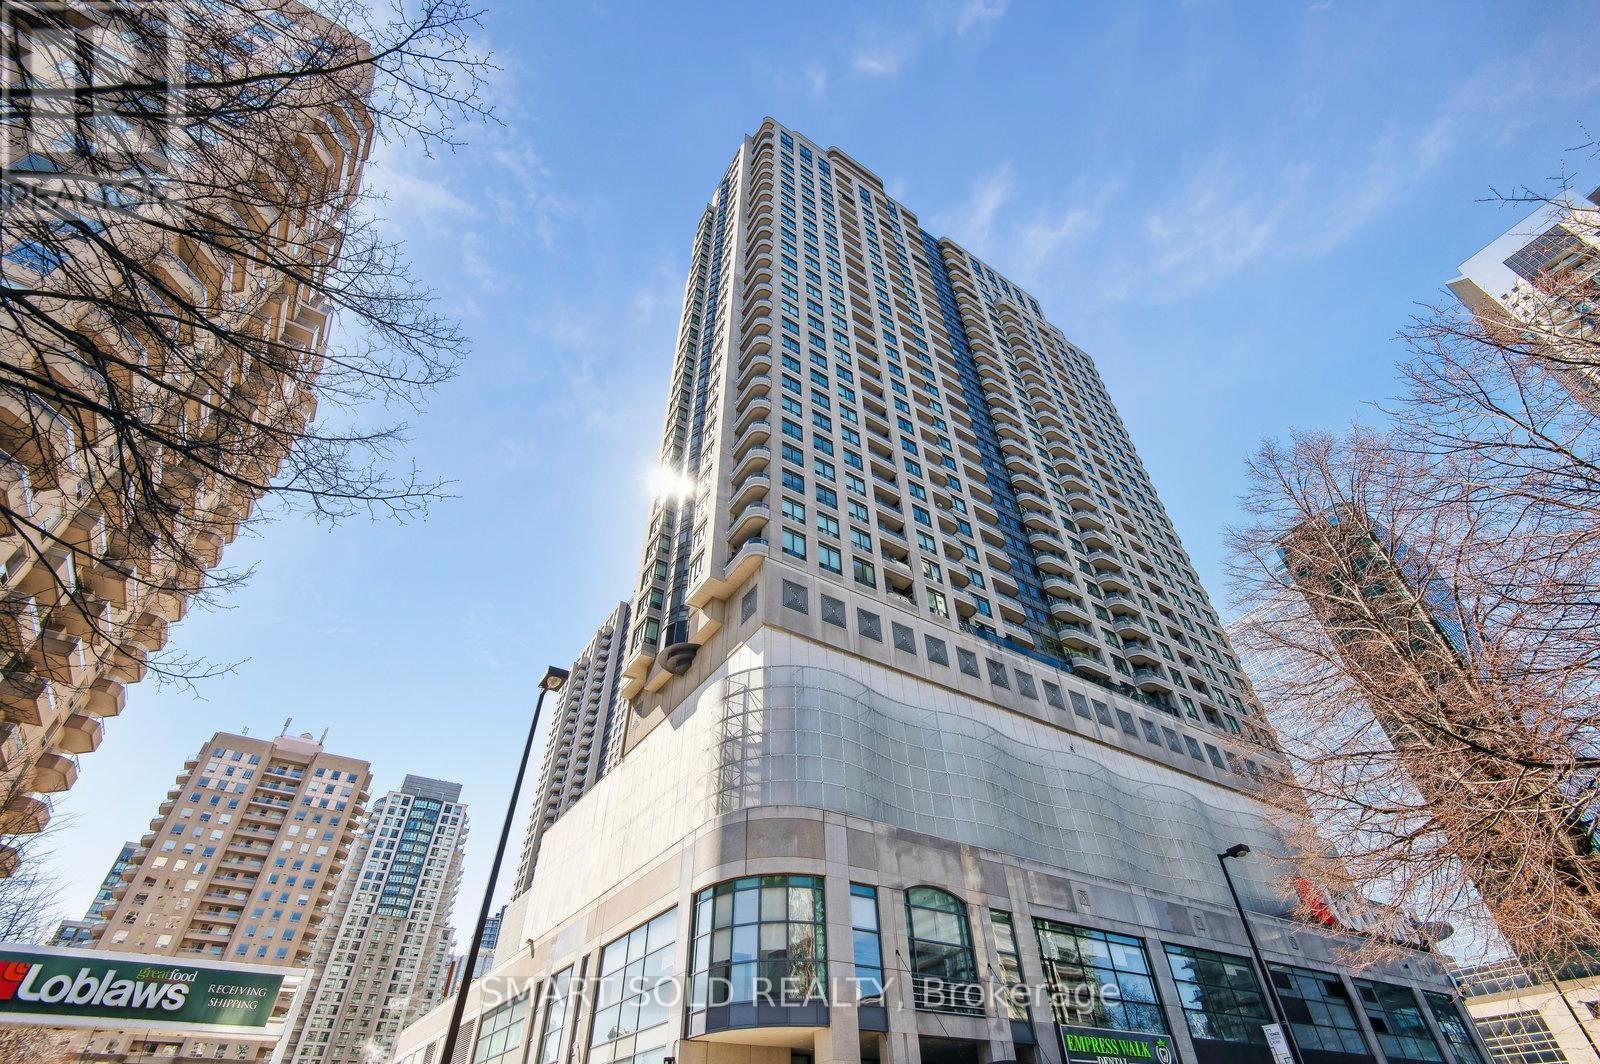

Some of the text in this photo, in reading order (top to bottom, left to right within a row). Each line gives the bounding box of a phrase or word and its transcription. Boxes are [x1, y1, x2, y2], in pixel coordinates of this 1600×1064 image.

[17, 963, 189, 1011] Loblaws
[208, 984, 268, 998] RECEIVING
[208, 997, 259, 1010] SHIPPING
[1066, 1034, 1152, 1058] EMPRESS WALK
